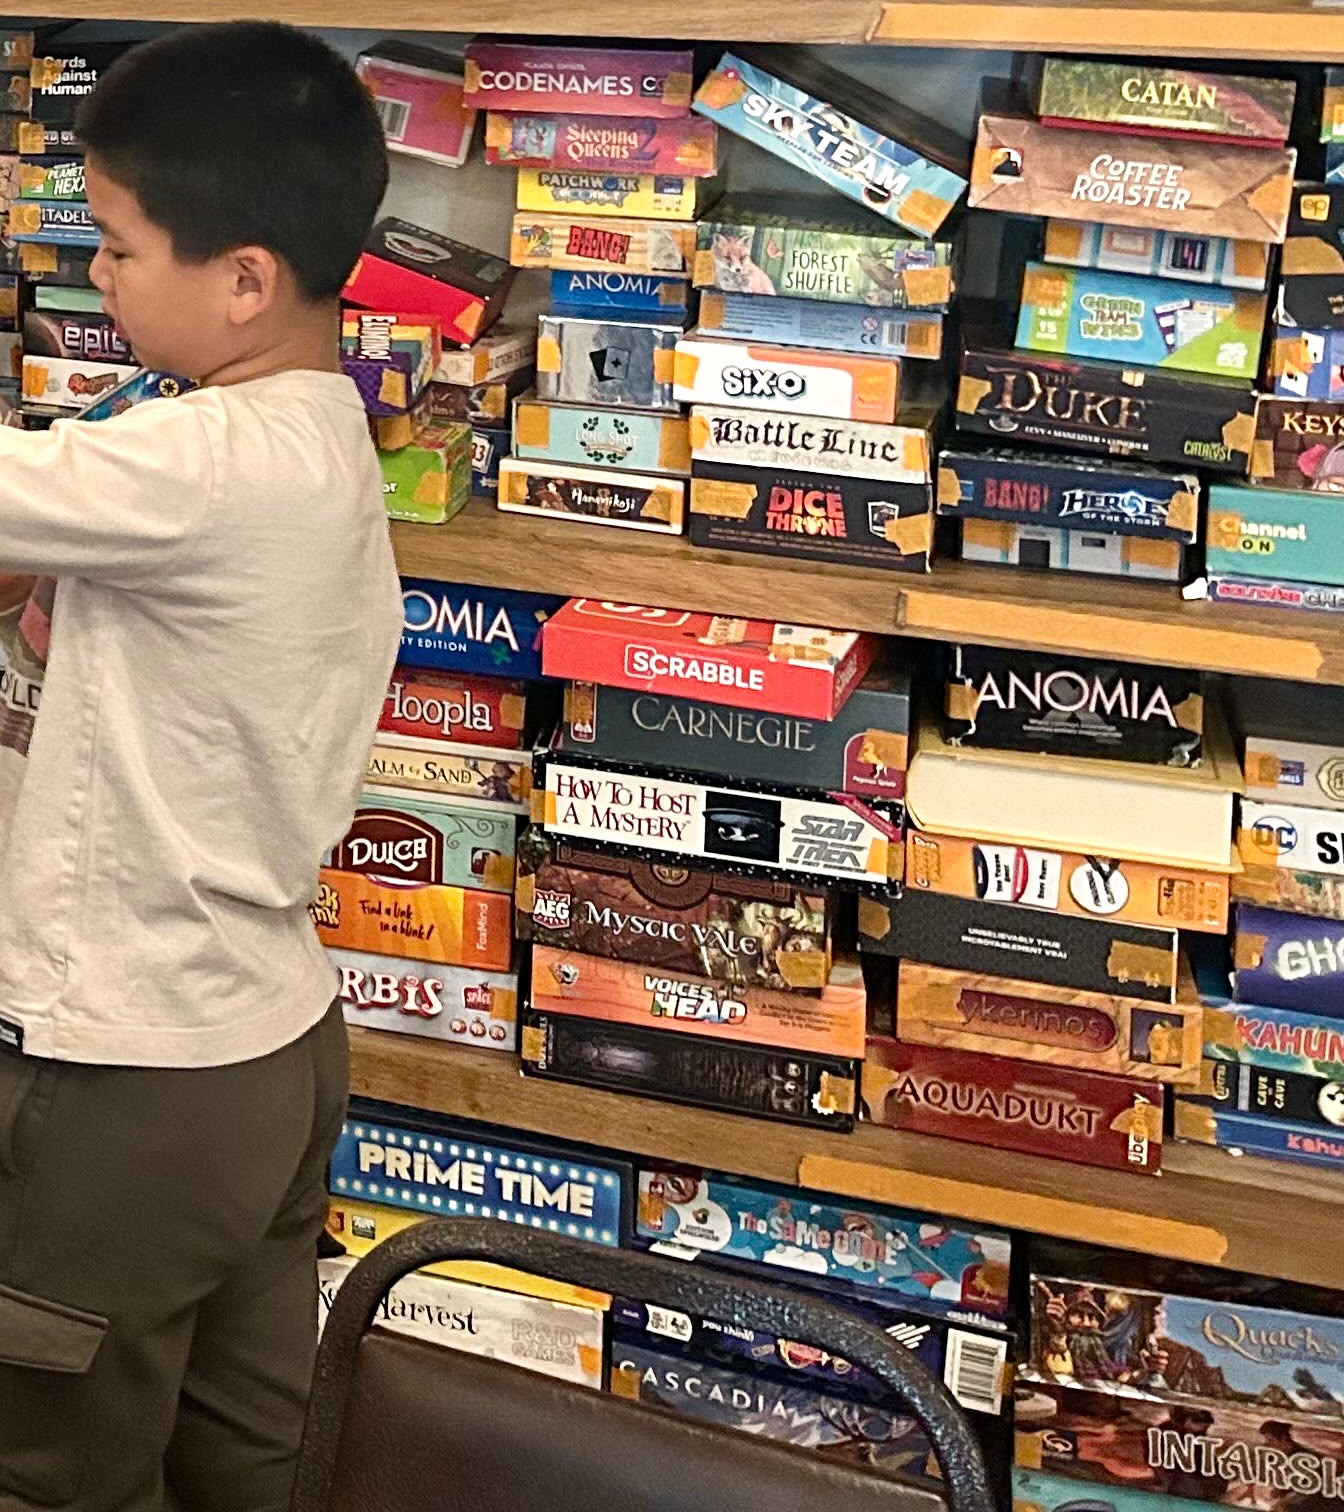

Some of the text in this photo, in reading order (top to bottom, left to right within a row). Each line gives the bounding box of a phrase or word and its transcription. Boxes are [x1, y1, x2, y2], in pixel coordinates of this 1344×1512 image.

[41, 70, 97, 84] Against
[43, 56, 87, 70] Cards
[477, 70, 634, 97] CODENAMES
[1120, 77, 1218, 109] CATAN
[566, 125, 639, 148] Sleeping
[567, 141, 631, 161] Queens
[741, 93, 911, 195] SKY TEAM
[538, 172, 638, 192] PATCHWORK
[1088, 153, 1185, 187] COFFEE
[1070, 176, 1192, 212] ROASTER
[567, 224, 631, 264] BANG!
[791, 249, 848, 273] FOREST
[785, 271, 853, 295] SHUFFLE
[995, 367, 1147, 431] DUKE
[711, 417, 900, 462] Battle Line
[769, 487, 845, 516] DICE
[765, 509, 848, 539] THRONE
[418, 639, 467, 653] EDITION
[631, 651, 764, 691] SCRABBLE
[975, 669, 1179, 727] ANOMIA
[631, 695, 817, 752] CARNEGIE
[423, 763, 473, 785] SAND
[555, 774, 696, 815] HOW TO HOST
[562, 804, 689, 842] A MYSTERY
[791, 813, 865, 842] STAR
[791, 842, 868, 869] TREK
[533, 897, 570, 921] AEG
[585, 900, 686, 941] MYSTIC
[643, 976, 713, 1003] VOICES
[654, 993, 748, 1026] HEAD
[894, 1075, 1101, 1137] AQUADUKT
[357, 1141, 596, 1219] PRIME TIME
[1202, 1311, 1339, 1366] Quacks
[619, 1360, 789, 1420] CASCADIA
